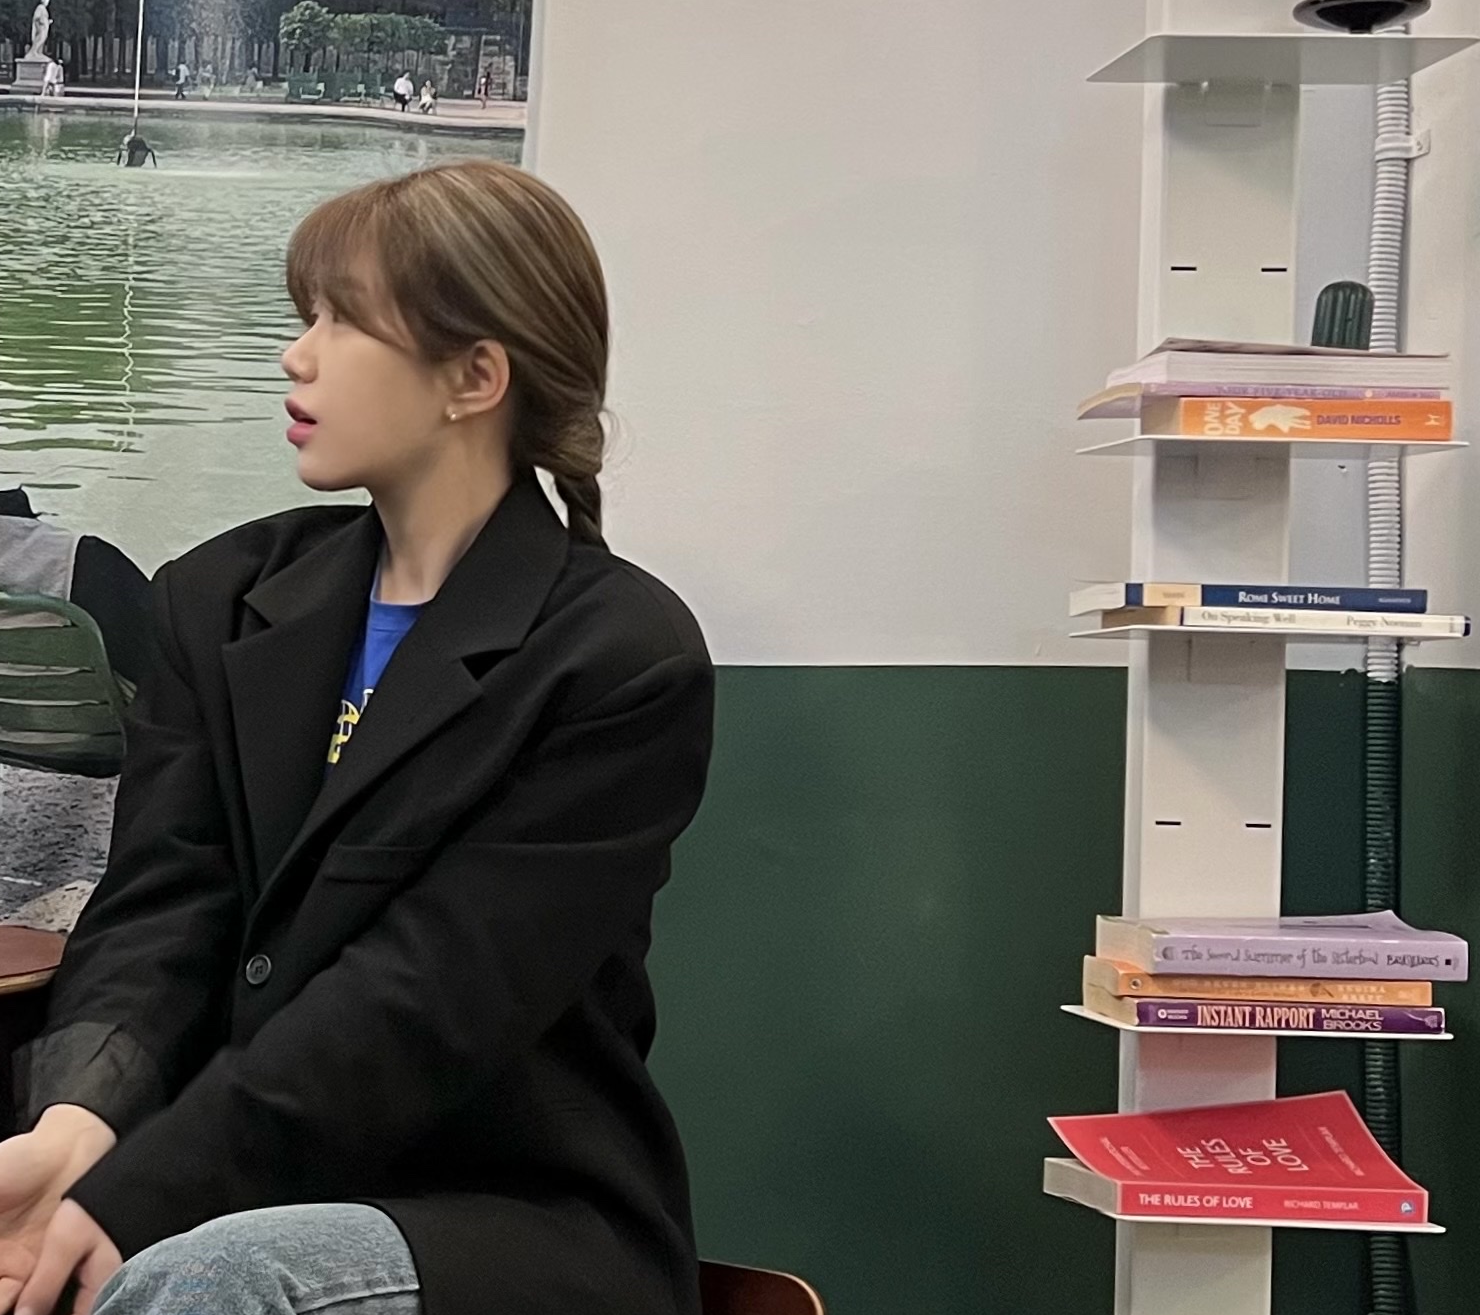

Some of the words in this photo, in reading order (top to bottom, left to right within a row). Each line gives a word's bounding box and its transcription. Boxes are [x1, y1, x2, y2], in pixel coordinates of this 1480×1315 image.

[1204, 401, 1223, 435] ONE
[1225, 401, 1247, 435] DAY
[1316, 415, 1349, 426] DAVID
[1351, 415, 1401, 426] NICHOLLS
[1238, 591, 1268, 603] ROME
[1271, 592, 1305, 604] SWEET
[1307, 593, 1341, 605] HOME
[1202, 611, 1218, 621] On
[1220, 611, 1270, 624] Speaking
[1273, 612, 1296, 624] Well
[1296, 948, 1308, 969] of
[1197, 1005, 1253, 1028] INSTANT
[1255, 1006, 1316, 1029] RAPPORT
[1321, 1008, 1384, 1021] MICHAEL
[1323, 1019, 1383, 1031] BROOKS
[1176, 1147, 1215, 1169] THE
[1201, 1138, 1253, 1174] RULES
[1239, 1148, 1272, 1166] OF
[1262, 1138, 1310, 1171] LOVE
[1139, 1193, 1161, 1206] THE
[1163, 1194, 1201, 1207] RULES
[1202, 1195, 1220, 1208] OF
[1222, 1196, 1254, 1209] LOVE
